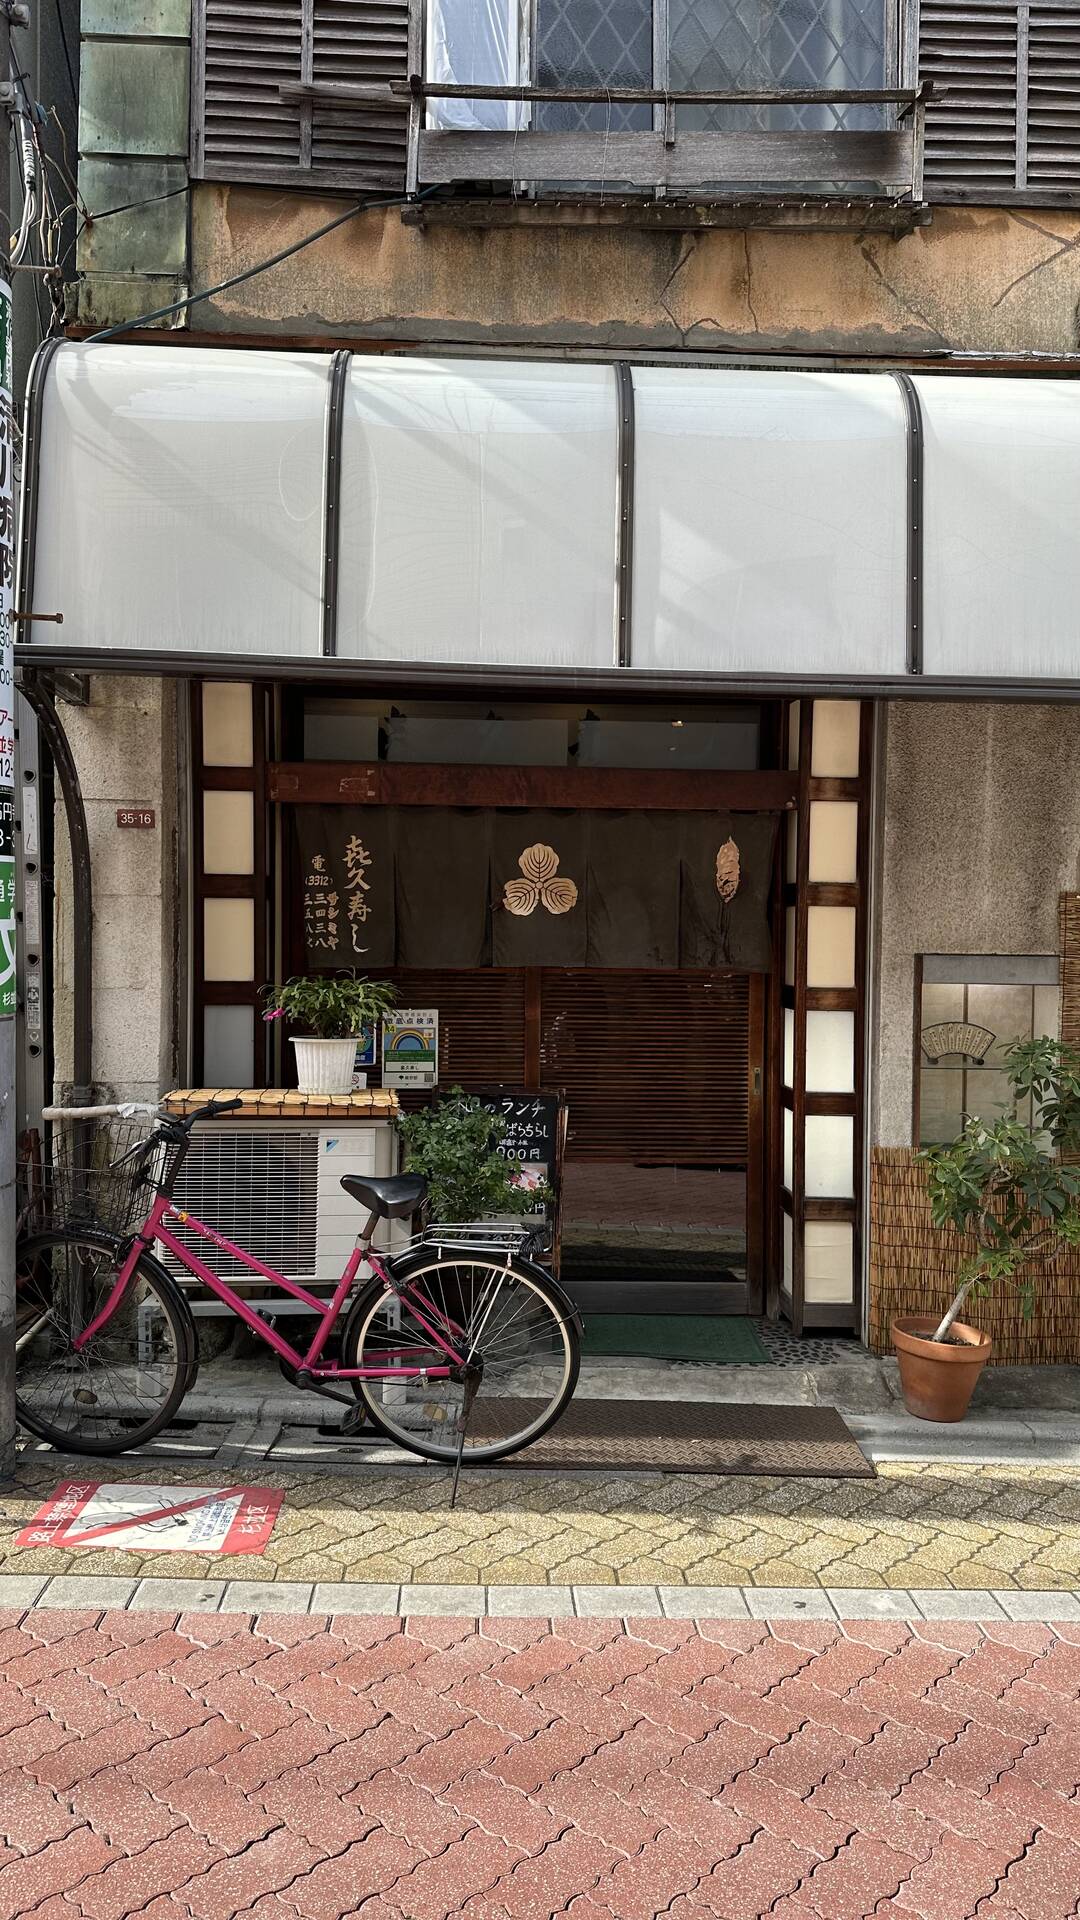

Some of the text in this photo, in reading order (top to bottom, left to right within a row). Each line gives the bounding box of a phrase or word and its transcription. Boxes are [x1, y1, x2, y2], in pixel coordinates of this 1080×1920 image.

[120, 813, 152, 824] 35-16
[27, 1484, 91, 1543] 路上禁煙地区
[238, 1504, 270, 1534] 杉並区
